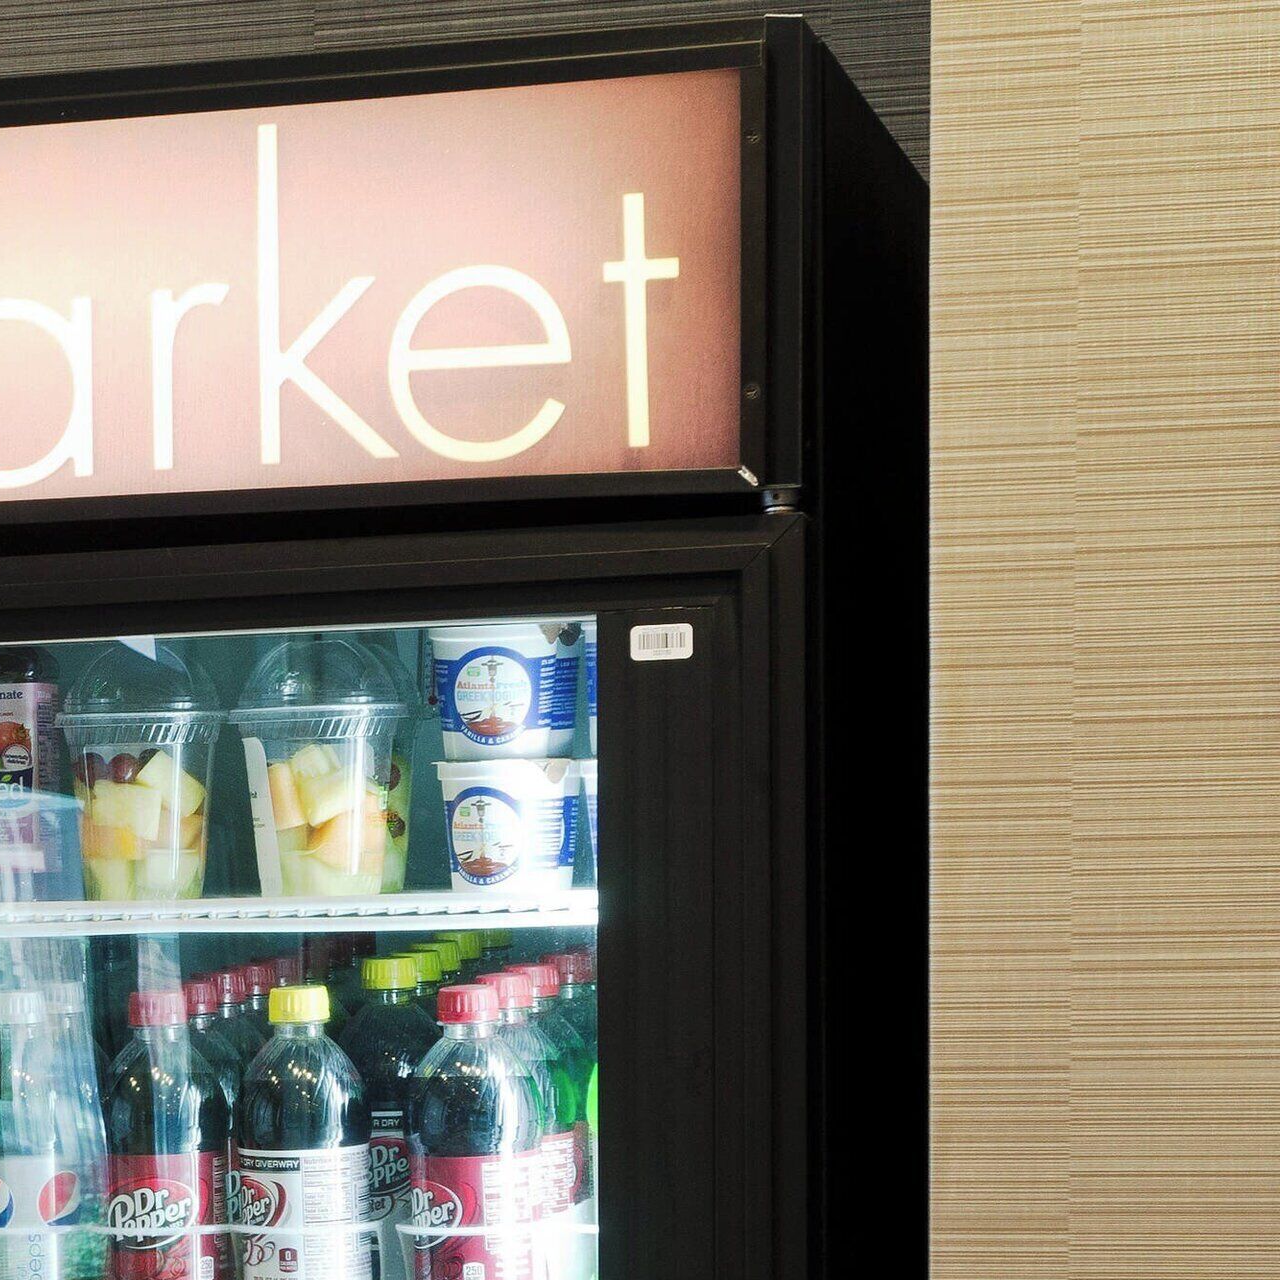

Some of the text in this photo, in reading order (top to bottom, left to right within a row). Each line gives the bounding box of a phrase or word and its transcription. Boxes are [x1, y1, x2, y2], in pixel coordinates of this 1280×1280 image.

[382, 1118, 400, 1126] DRY
[255, 1159, 300, 1169] GIVEAWAY
[370, 1145, 399, 1167] Dr
[133, 1187, 169, 1211] Dr
[108, 1194, 191, 1242] Pepper
